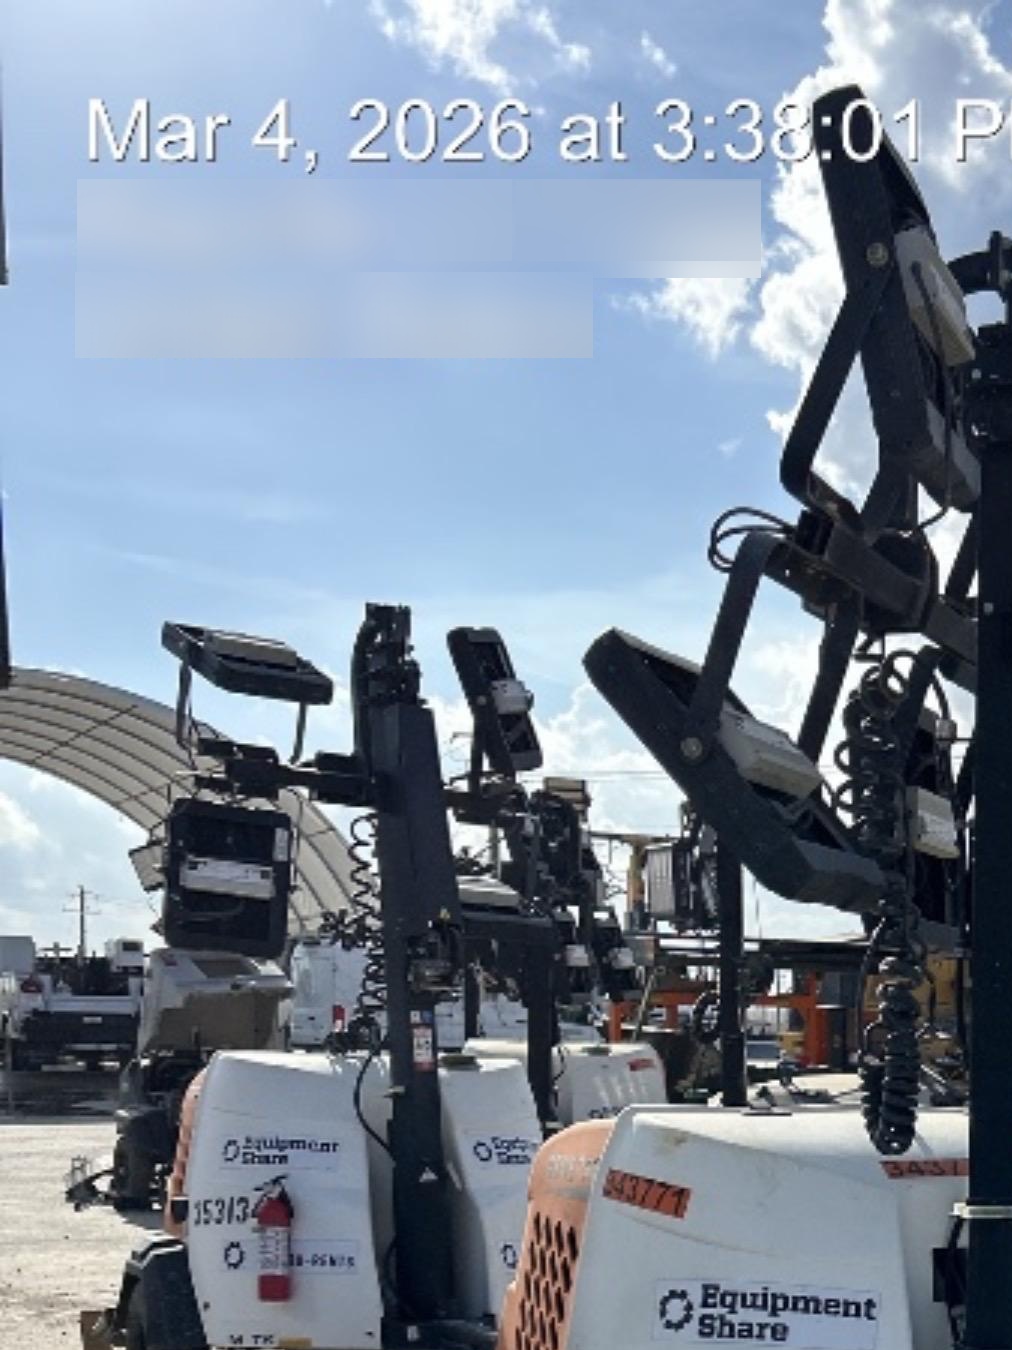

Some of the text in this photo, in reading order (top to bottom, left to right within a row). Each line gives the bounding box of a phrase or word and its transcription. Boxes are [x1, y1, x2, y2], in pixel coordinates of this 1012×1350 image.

[241, 1135, 340, 1153] Equipment
[701, 1283, 878, 1321] Equipment
[697, 1313, 790, 1342] Share
